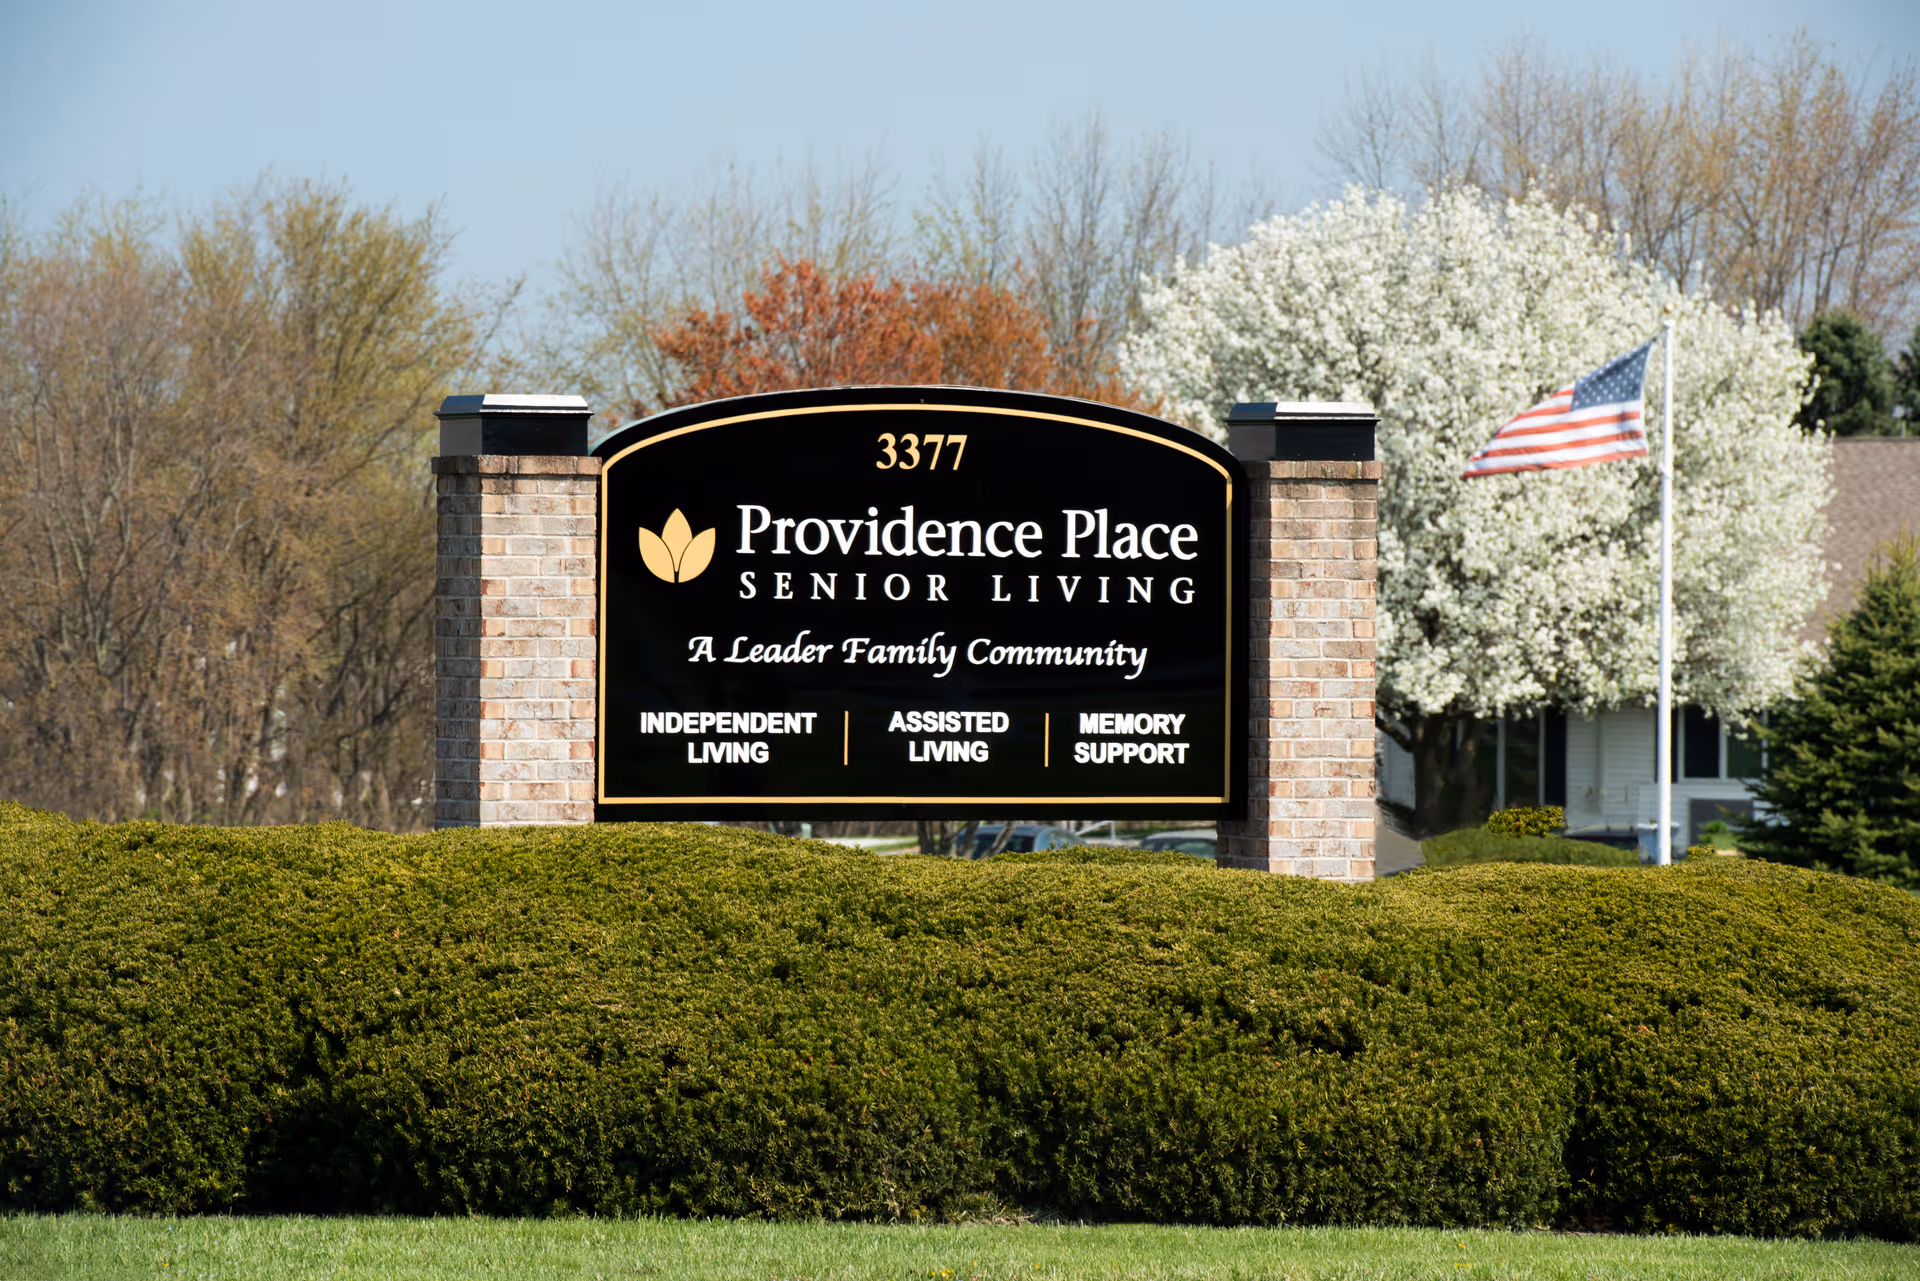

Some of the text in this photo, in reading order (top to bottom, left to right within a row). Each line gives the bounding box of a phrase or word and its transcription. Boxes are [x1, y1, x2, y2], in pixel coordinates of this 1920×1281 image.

[876, 433, 967, 470] 3377
[736, 504, 1198, 560] Providence Place
[739, 571, 1196, 604] SENIOR LIVING
[688, 630, 1147, 679] A Leader Family Community
[640, 711, 817, 734] INDEPENDENT
[888, 711, 1010, 733] ASSISTED
[1079, 713, 1186, 735] MEMORY
[687, 742, 770, 764] LIVING
[908, 740, 989, 762] LIVING
[1073, 742, 1190, 765] SUPPORT
